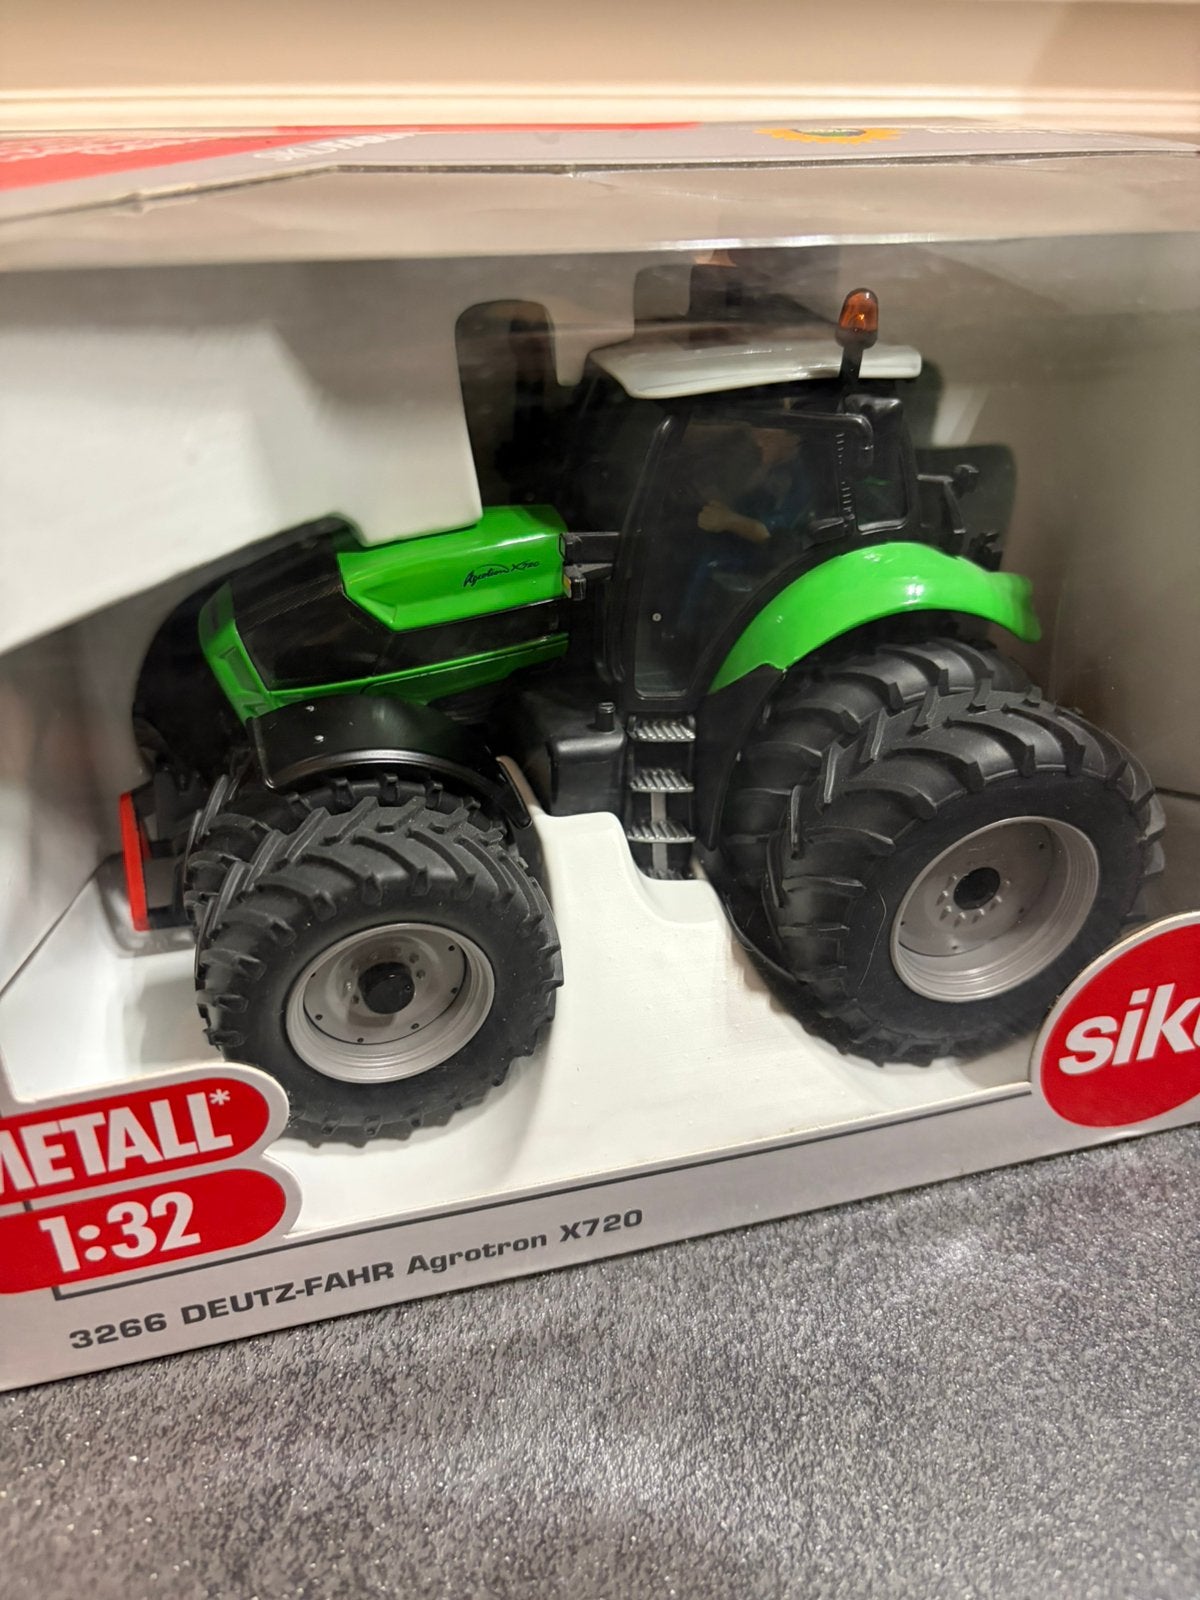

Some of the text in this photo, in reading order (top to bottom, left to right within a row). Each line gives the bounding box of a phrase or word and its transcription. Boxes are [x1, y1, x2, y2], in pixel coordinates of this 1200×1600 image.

[1058, 982, 1200, 1076] sik
[38, 1191, 201, 1274] 1:32
[69, 1208, 643, 1350] 3266 DEUTZ-FAHR Agrotron X720
